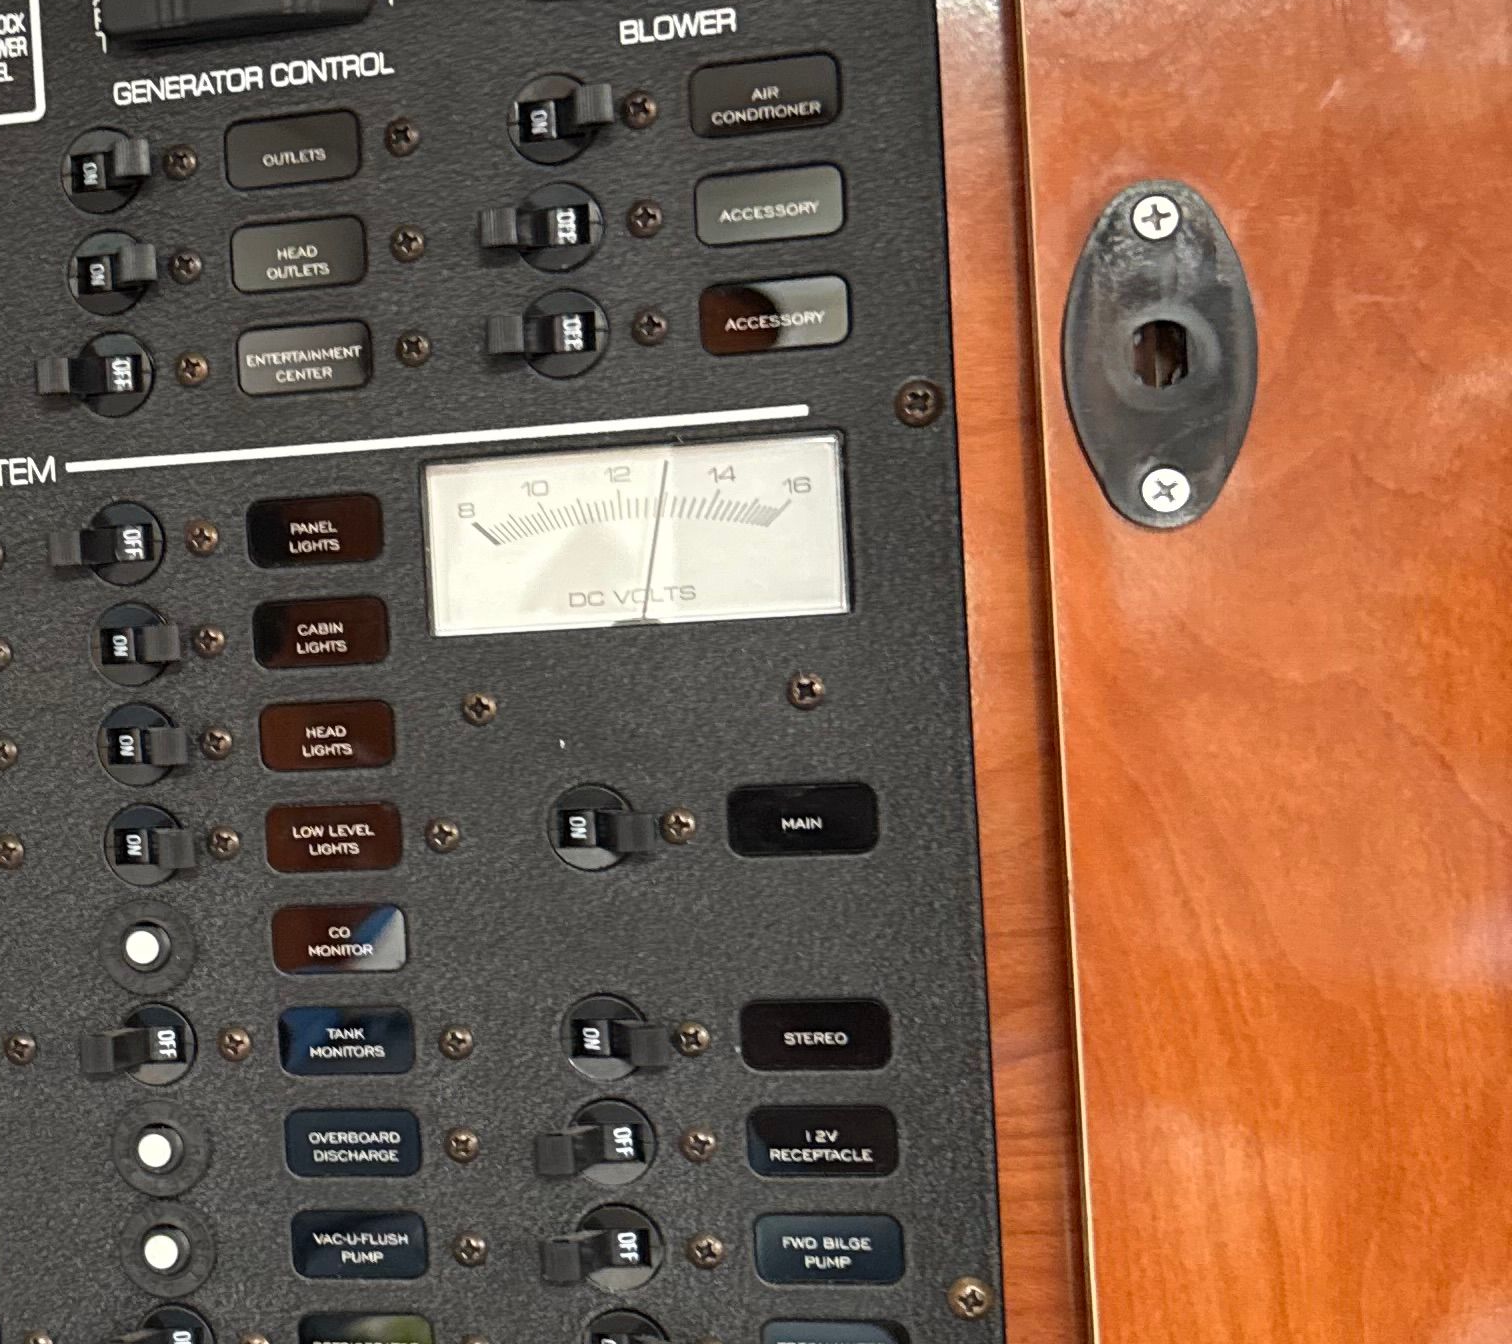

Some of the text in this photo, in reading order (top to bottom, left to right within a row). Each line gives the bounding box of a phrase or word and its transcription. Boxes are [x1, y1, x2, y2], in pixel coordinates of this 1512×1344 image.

[618, 8, 737, 45] BLOWER
[113, 52, 395, 106] GENERATOR CONTROL
[751, 86, 779, 101] AIR
[711, 101, 822, 126] CONDITIONER
[262, 149, 327, 168] OUTLETS
[719, 201, 820, 224] ACCESSORY
[277, 246, 318, 261] HEAD
[266, 263, 330, 280] OUTLETS
[724, 310, 826, 333] ACCESSORY
[246, 345, 362, 368] ENTERTAINMENT
[275, 367, 333, 383] CENTER
[603, 465, 631, 483] 12
[708, 465, 736, 484] 14
[521, 479, 549, 497] 10
[782, 476, 812, 494] 16
[457, 502, 475, 519] 8
[290, 521, 337, 535] PANEL
[289, 539, 340, 554] LIGHTS
[569, 585, 697, 608] DC VOLTS
[297, 622, 344, 636] CABIN
[296, 641, 347, 655] LIGHTS
[305, 726, 347, 738] HEAD
[302, 743, 353, 757] LIGHTS
[292, 824, 375, 839] LOW LEVEL
[781, 817, 823, 831] MAIN
[309, 843, 359, 856] LIGHTS
[308, 944, 374, 956] MONITOR
[326, 1028, 365, 1040] TANK
[783, 1032, 848, 1046] STEREO
[309, 1046, 385, 1058] MONITORS
[308, 1132, 401, 1145] OVERBOARD
[314, 1149, 399, 1163] DISCHARGE
[769, 1148, 873, 1163] RECEPTACLE
[313, 1233, 409, 1245] VAC-U-FLUSH
[782, 1237, 872, 1250] FWD BILGE
[805, 1256, 852, 1270] PUMP
